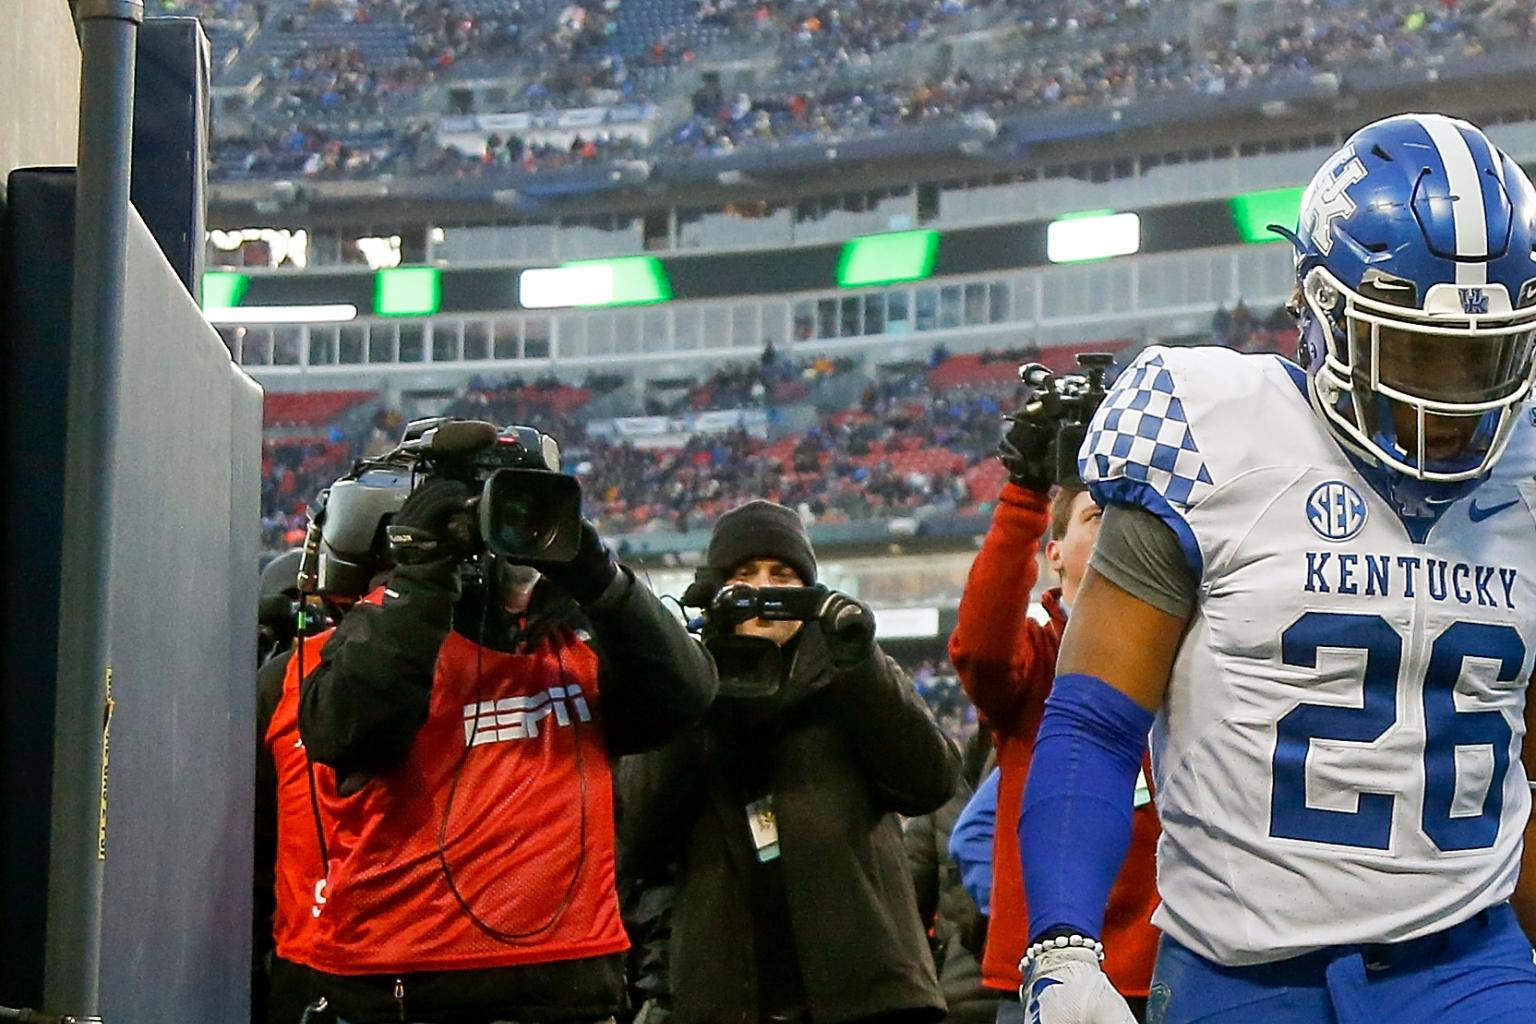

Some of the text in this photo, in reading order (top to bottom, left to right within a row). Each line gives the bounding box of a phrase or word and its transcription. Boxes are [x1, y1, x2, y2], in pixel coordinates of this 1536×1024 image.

[1307, 483, 1367, 540] SEC
[1304, 551, 1517, 610] KENTUCKY
[463, 683, 592, 748] ESPN
[1268, 611, 1527, 853] 26
